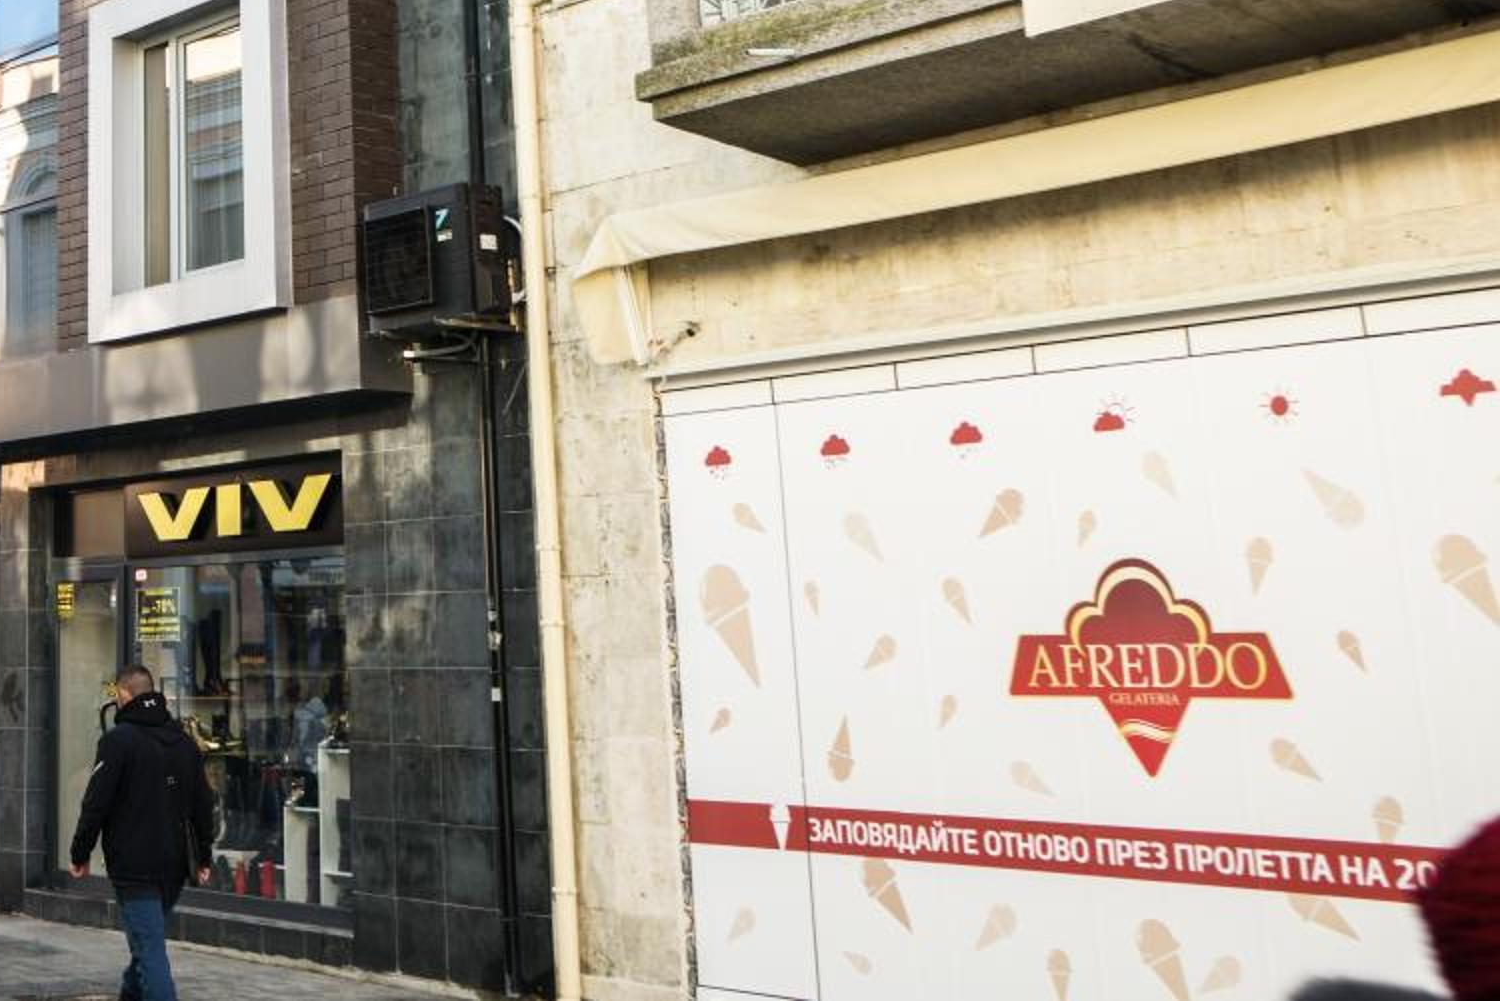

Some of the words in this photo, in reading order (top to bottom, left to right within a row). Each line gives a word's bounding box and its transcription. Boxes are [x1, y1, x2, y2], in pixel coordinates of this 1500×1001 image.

[137, 472, 332, 543] VIV
[1027, 642, 1268, 690] AFREDDO
[1107, 692, 1181, 706] GELATERIA
[807, 817, 980, 856] ЗАПОВЯДАЙТЕ
[984, 830, 1089, 864] ОТНОВО
[1095, 837, 1169, 871] ПРЕЗ
[1172, 842, 1336, 884] ПРОЛЕТТА
[1339, 854, 1391, 889] НА
